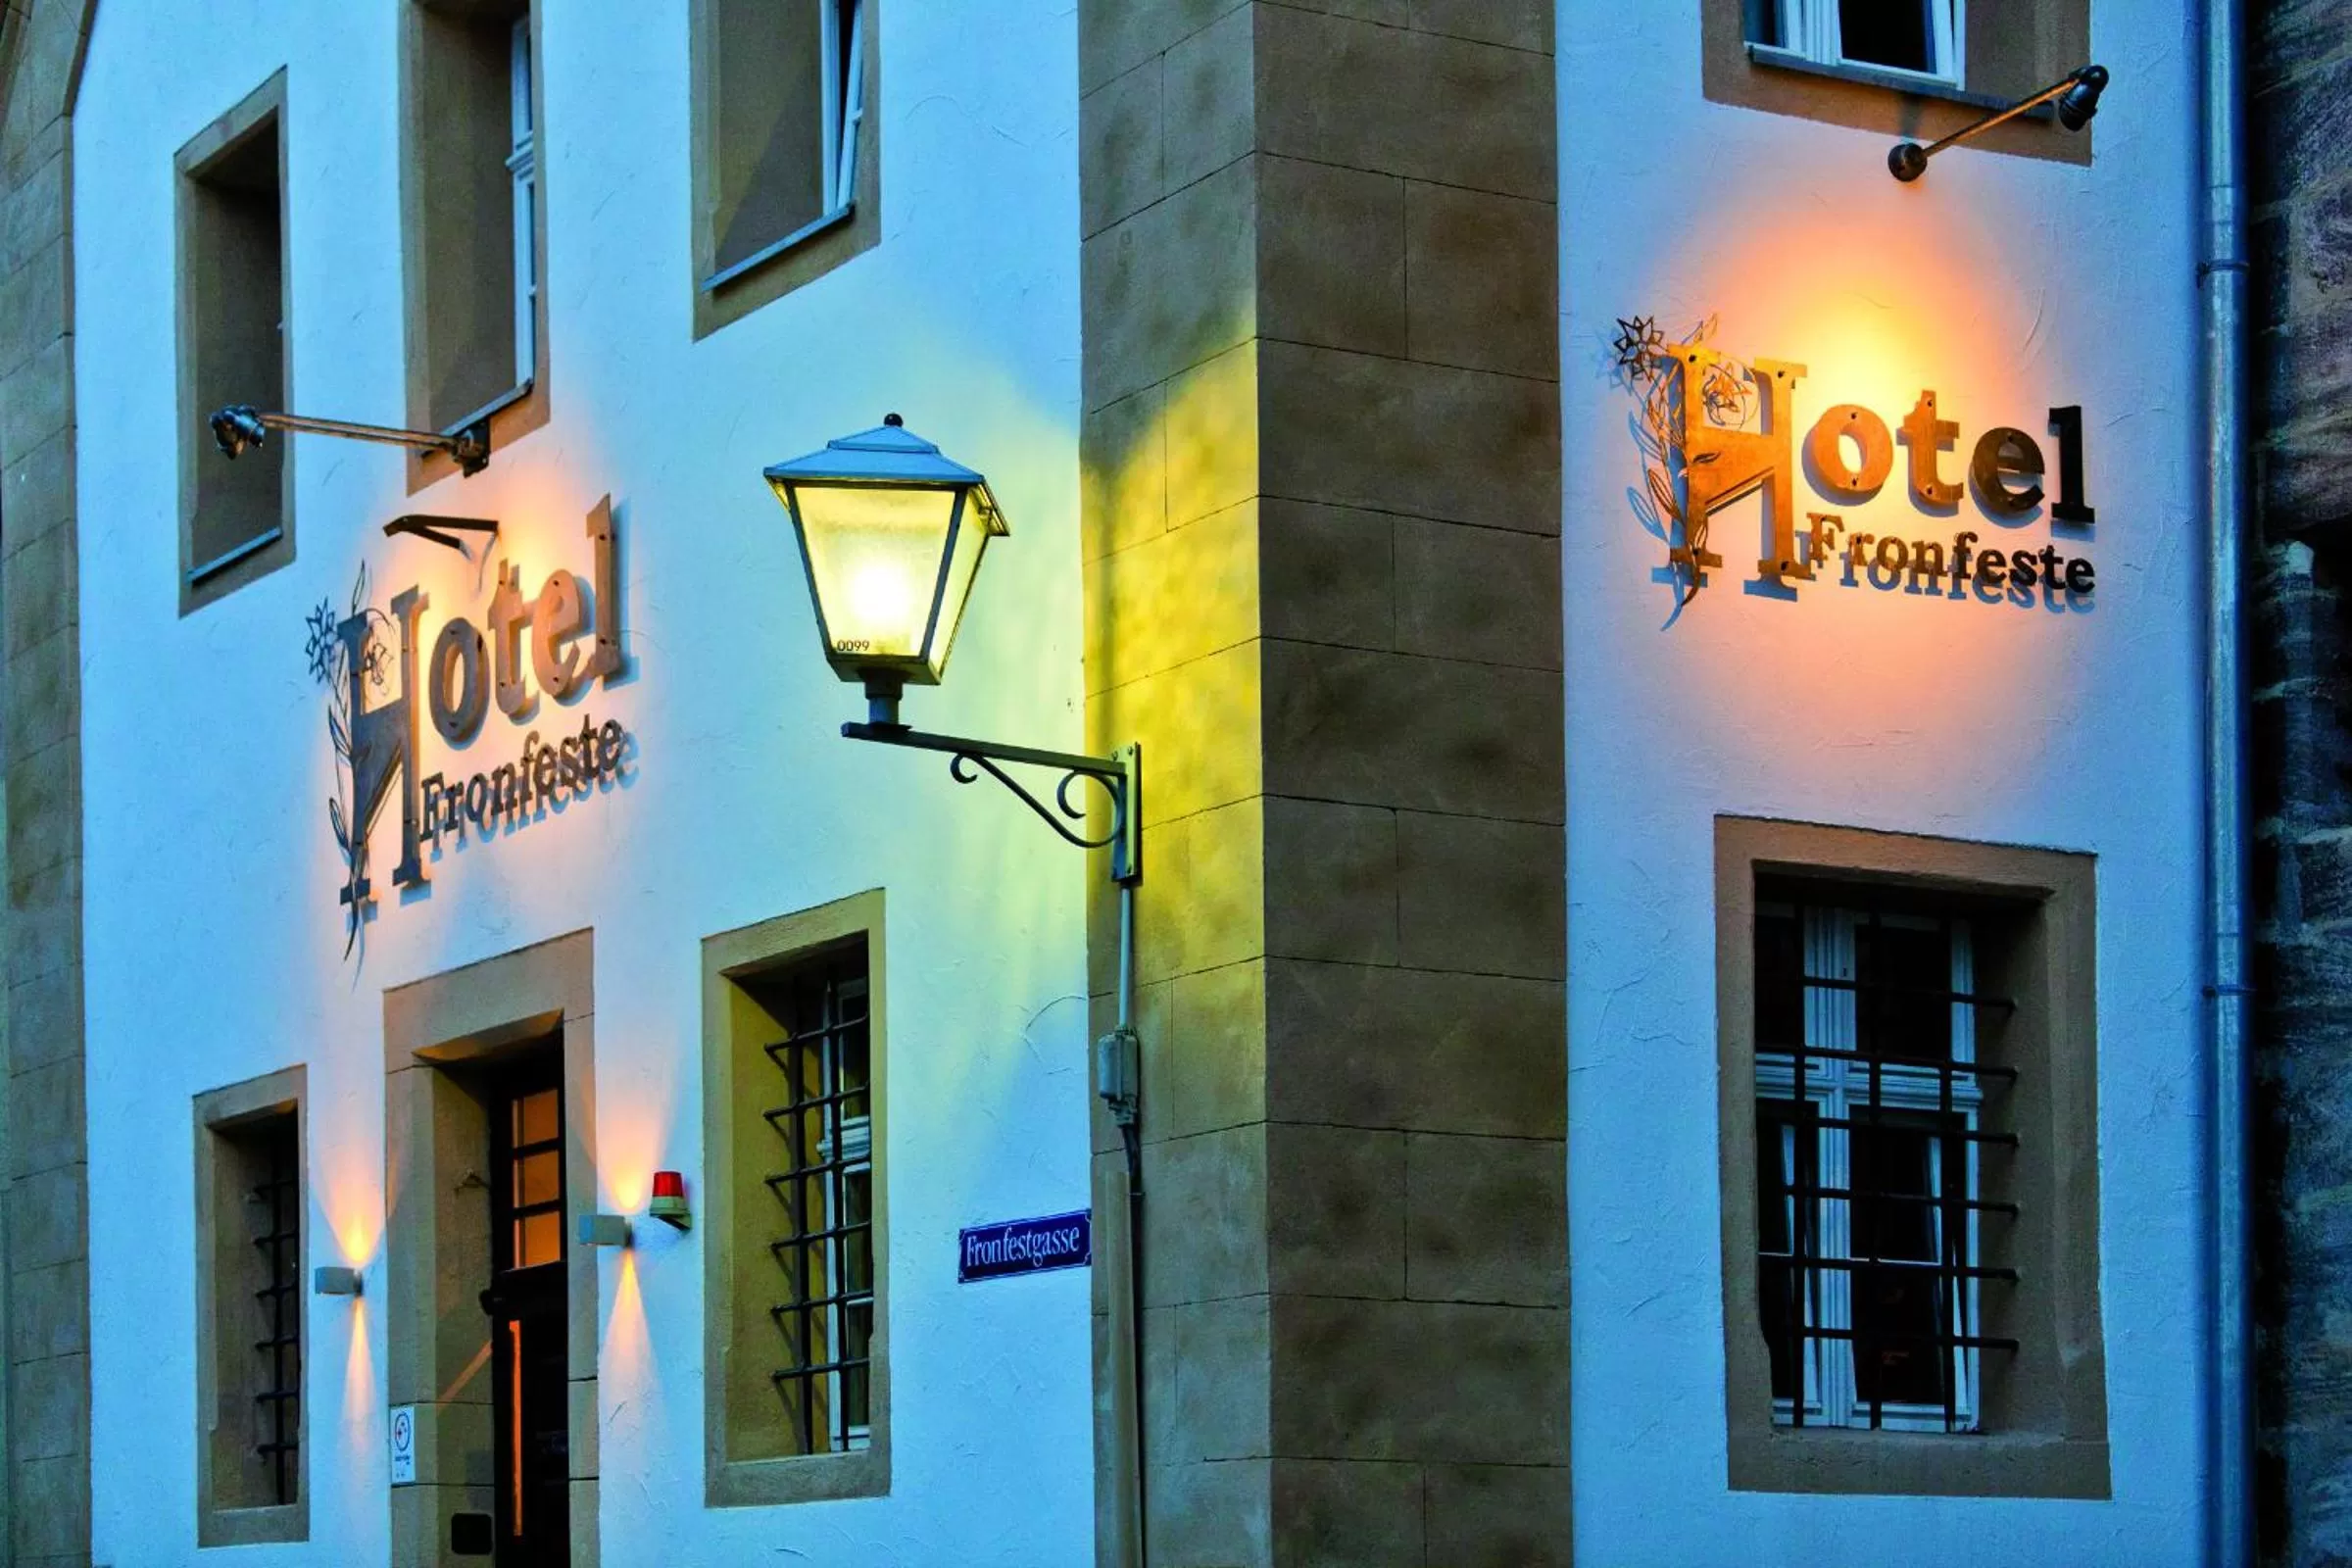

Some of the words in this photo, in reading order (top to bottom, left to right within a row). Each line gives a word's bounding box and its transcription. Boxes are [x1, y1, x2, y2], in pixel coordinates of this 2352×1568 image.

[1667, 342, 2095, 581] Hotel
[1805, 512, 2096, 595] Fronfeste
[837, 639, 870, 652] 0099
[337, 493, 622, 906] Hotel
[419, 713, 626, 842] Fronfeste
[966, 1227, 1080, 1267] Fronfestgasse
